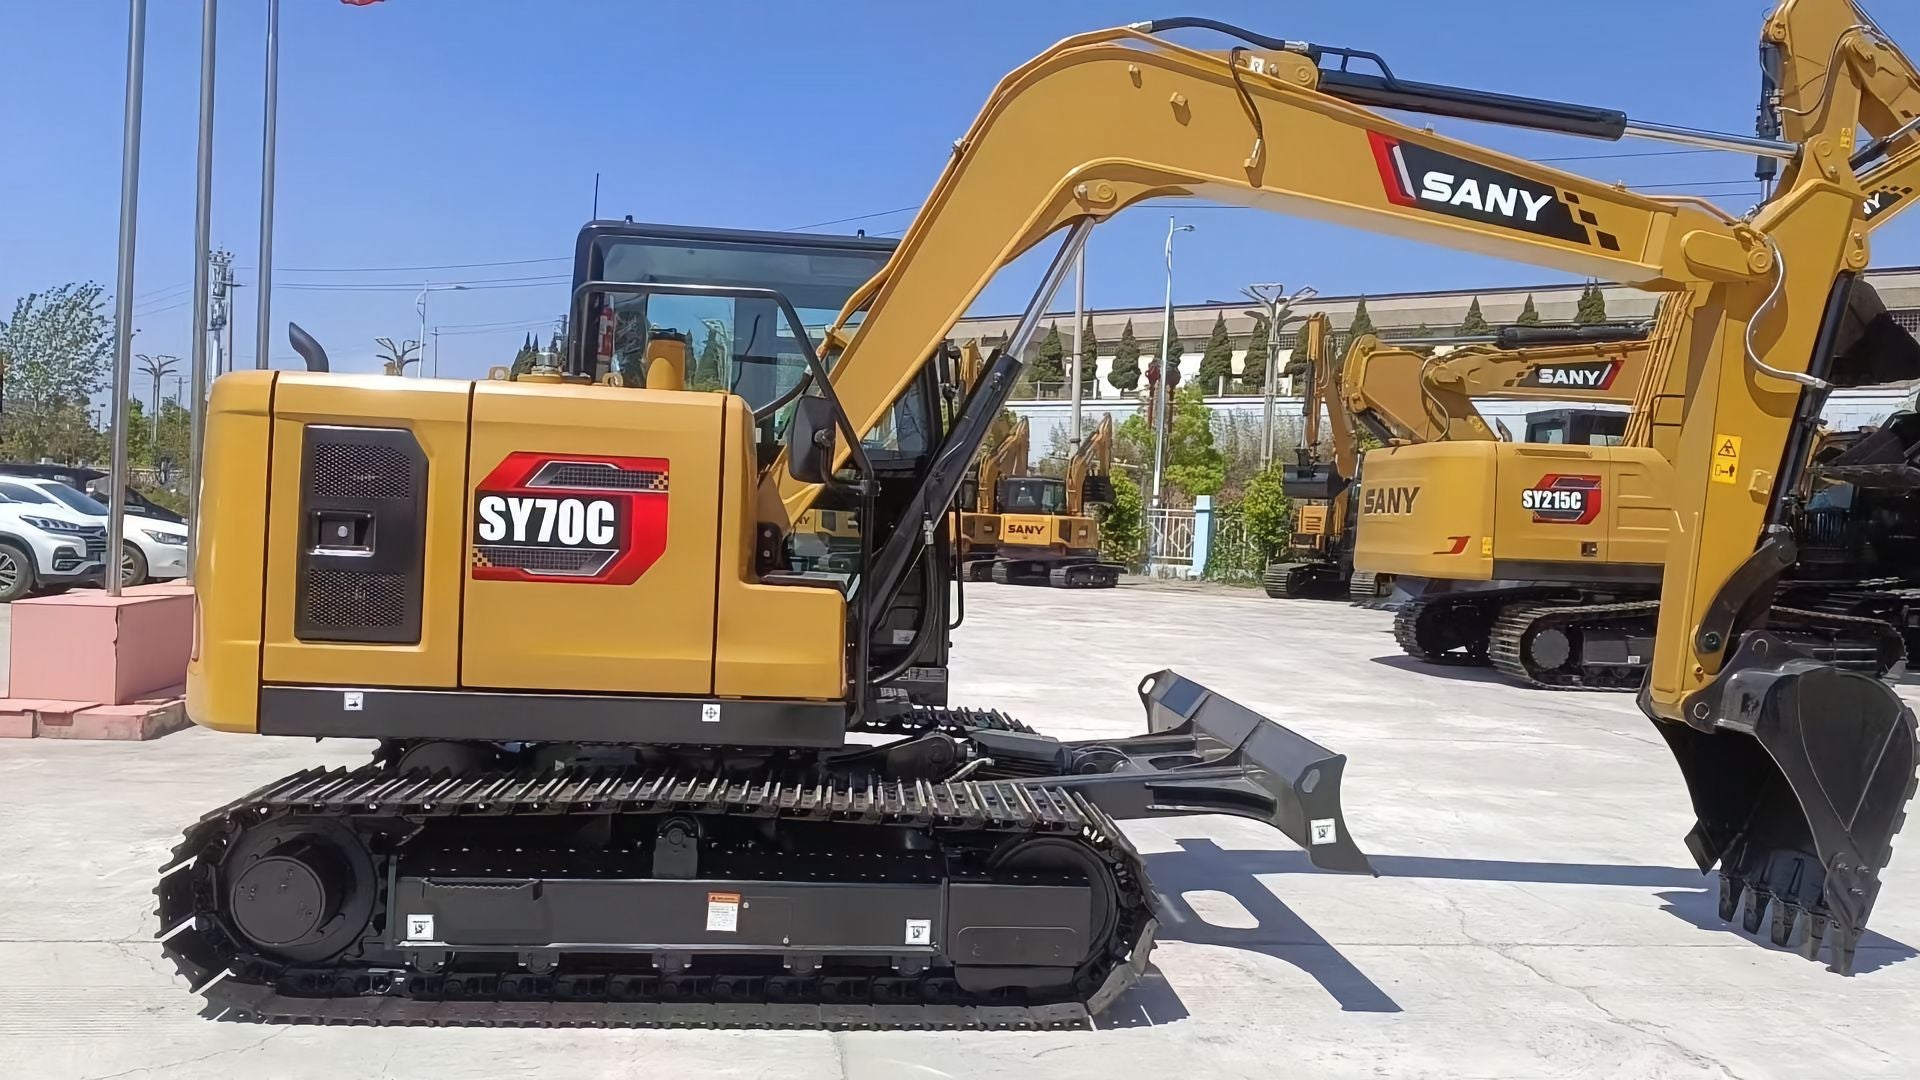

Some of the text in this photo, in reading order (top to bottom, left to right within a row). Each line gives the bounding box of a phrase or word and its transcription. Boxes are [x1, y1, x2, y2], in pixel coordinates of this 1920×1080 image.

[1421, 171, 1552, 222] SANY
[1538, 368, 1600, 386] SANY
[1363, 486, 1421, 514] SANY
[1522, 489, 1582, 510] SY215C
[478, 495, 616, 546] SY70C
[1008, 524, 1045, 535] SANY
